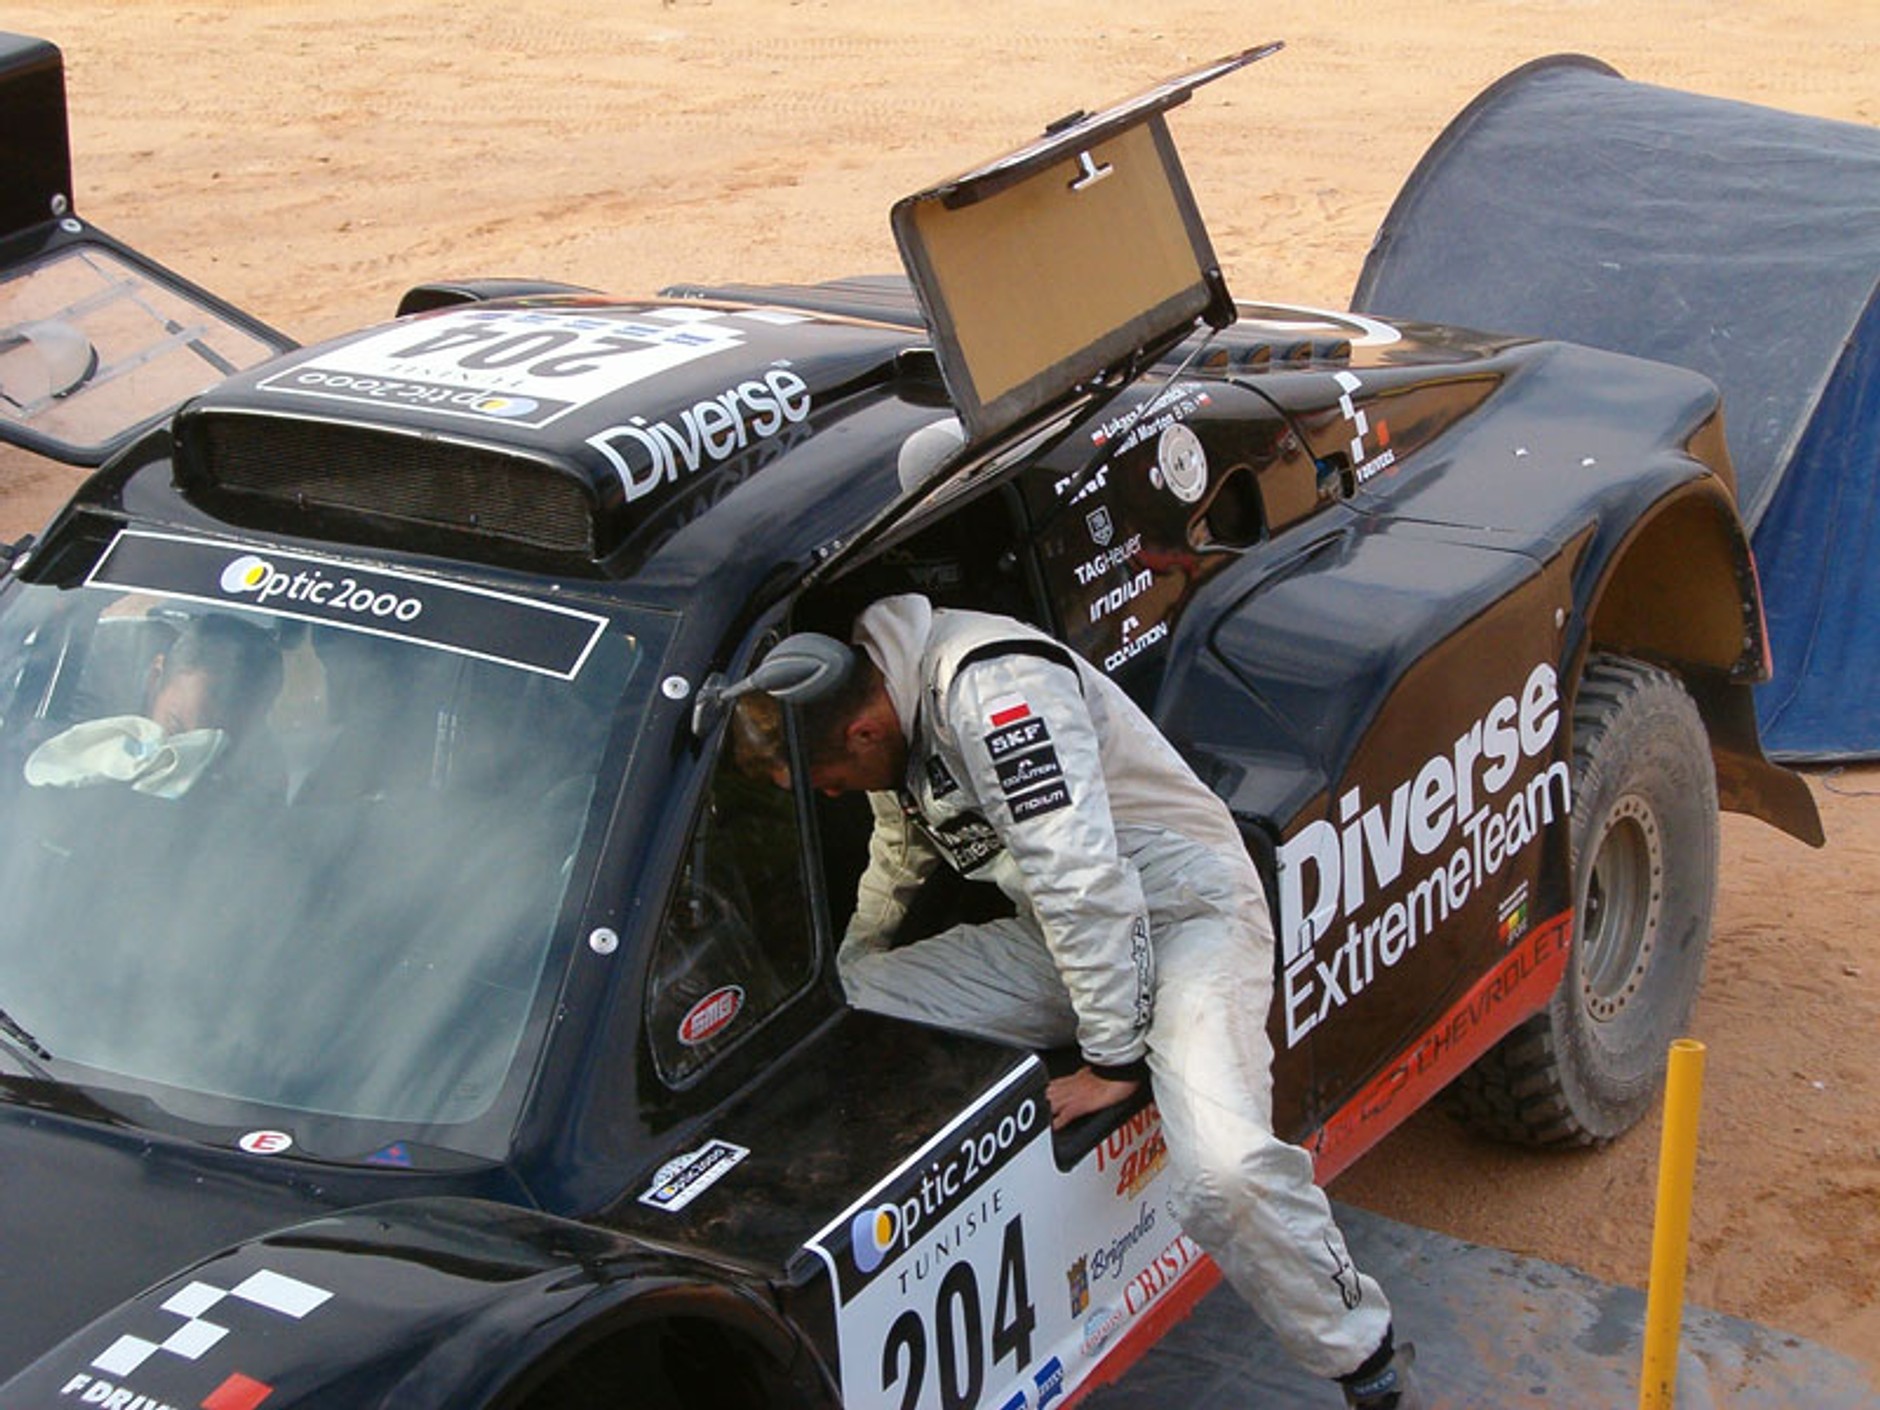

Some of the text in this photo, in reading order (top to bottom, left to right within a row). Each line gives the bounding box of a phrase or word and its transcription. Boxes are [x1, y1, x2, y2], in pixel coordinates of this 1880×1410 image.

[388, 323, 660, 378] 204
[586, 366, 811, 502] Diverse
[992, 723, 1041, 754] SKF
[1276, 662, 1560, 969] Diverse
[1417, 922, 1568, 1075] CHEVROLET
[251, 1133, 285, 1151] E
[898, 1188, 1003, 1295] TUNISIE
[881, 1212, 1036, 1410] 204
